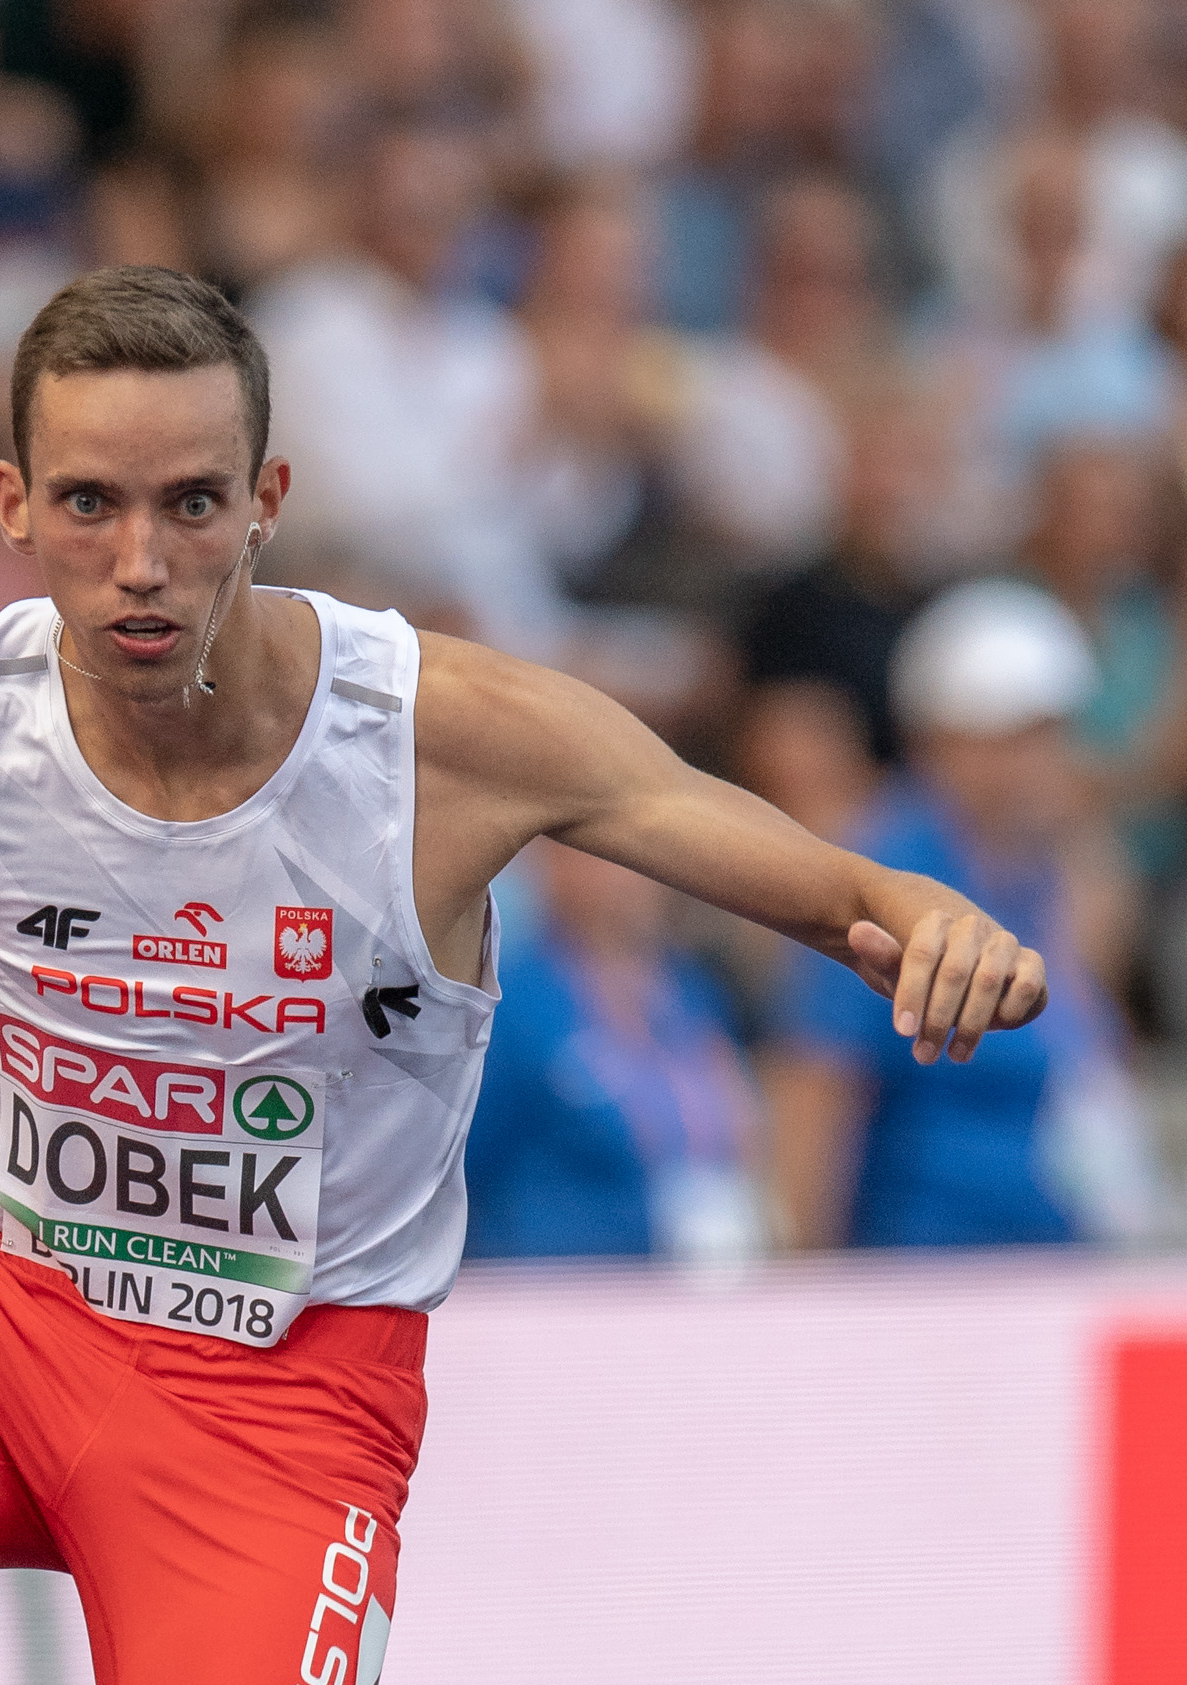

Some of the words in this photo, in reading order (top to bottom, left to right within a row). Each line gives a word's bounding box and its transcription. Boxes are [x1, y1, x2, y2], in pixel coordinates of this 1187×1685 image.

[16, 905, 102, 950] 4F
[279, 909, 329, 922] POLSKA
[137, 939, 222, 966] ORLEN
[31, 965, 327, 1034] POLSKA
[0, 1024, 217, 1123] SPAR
[6, 1091, 303, 1242] DOBEK
[53, 1225, 117, 1256] RUN
[167, 1282, 275, 1339] 2018
